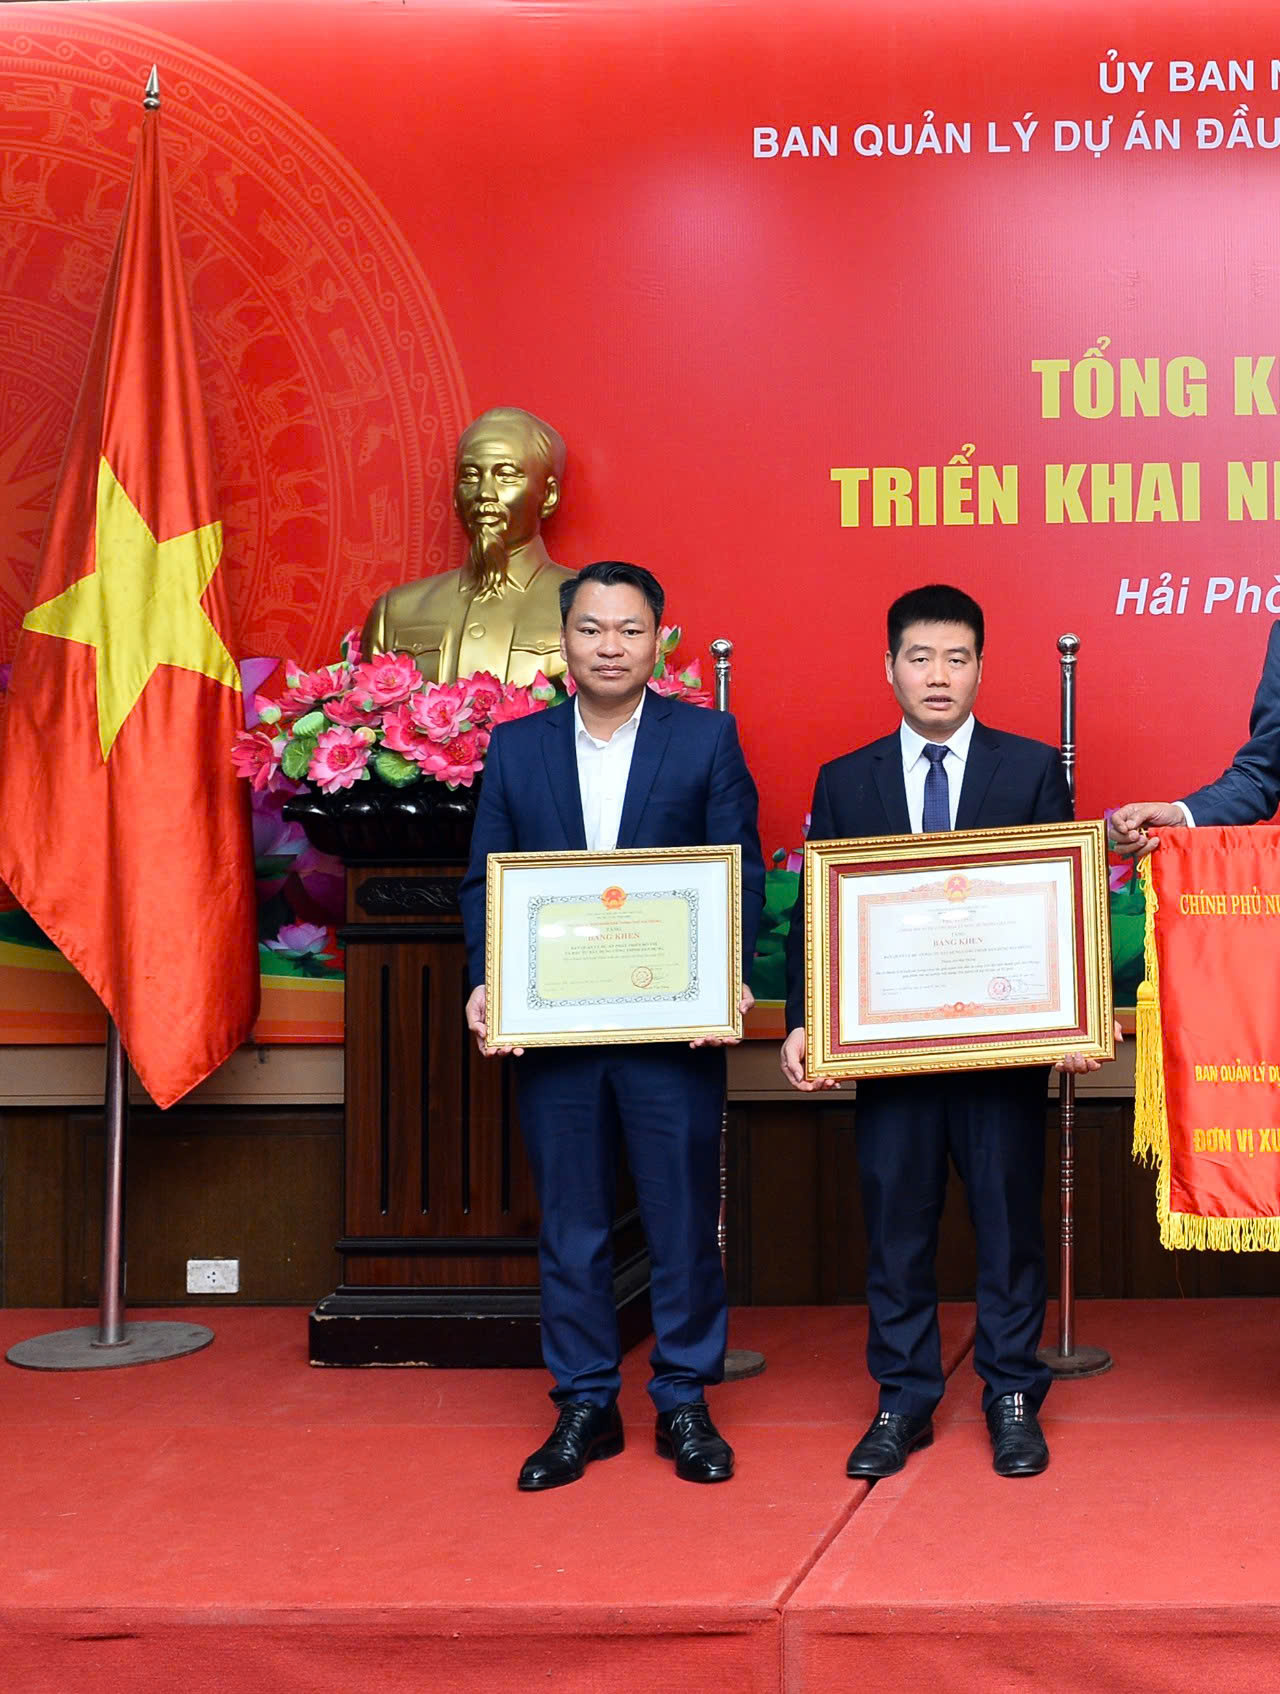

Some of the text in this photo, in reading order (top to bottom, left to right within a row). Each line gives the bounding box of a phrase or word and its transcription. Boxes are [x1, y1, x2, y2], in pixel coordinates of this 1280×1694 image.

[1099, 48, 1154, 94] ỦY
[1169, 60, 1254, 92] BAN
[753, 125, 838, 158] BAN
[853, 110, 971, 157] QUẢN
[988, 112, 1039, 153] LÝ
[1054, 115, 1114, 158] DỰ
[1124, 110, 1181, 151] ÁN
[1031, 335, 1208, 419] TỔNG
[830, 443, 1019, 528] TRIỂN
[1045, 463, 1201, 524] KHAI
[1115, 572, 1190, 615] Hải
[1179, 889, 1228, 915] CHÍNH
[1231, 886, 1261, 914] PHỦ
[1195, 1064, 1218, 1082] BAN
[1221, 1058, 1250, 1082] QUẢN
[1253, 1061, 1266, 1082] LÝ
[1193, 1127, 1232, 1152] ĐƠN
[1236, 1128, 1254, 1158] VỊ
